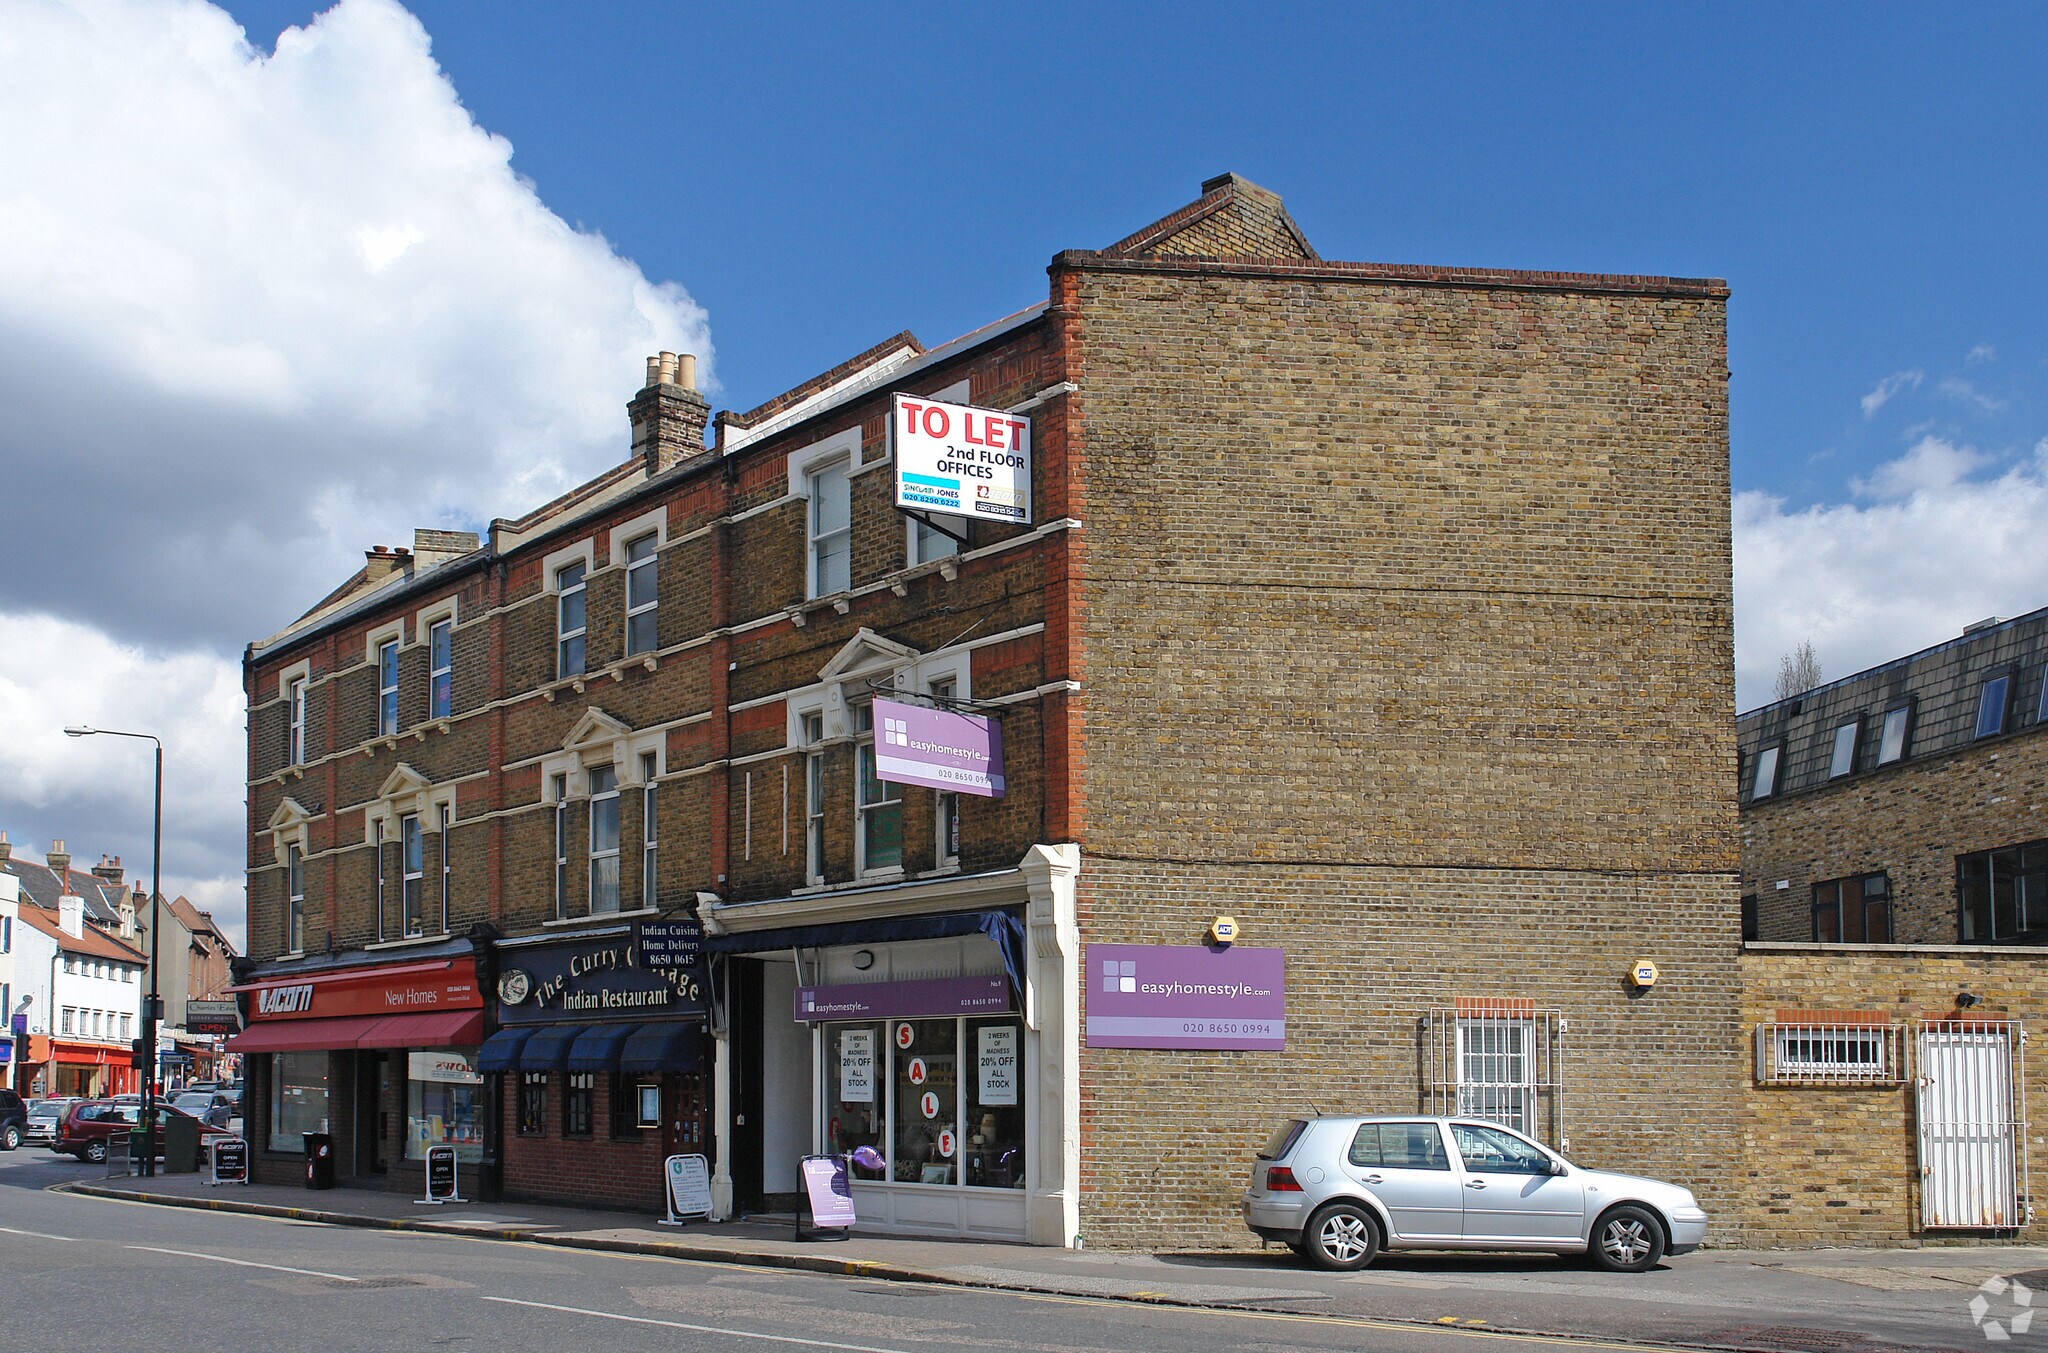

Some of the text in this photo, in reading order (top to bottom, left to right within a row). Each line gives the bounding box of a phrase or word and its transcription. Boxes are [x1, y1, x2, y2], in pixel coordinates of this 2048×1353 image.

[901, 402, 1026, 451] TO LET
[947, 445, 1025, 469] 2nd FLOOR
[937, 460, 993, 479] OFFICES
[936, 488, 959, 498] JONES
[910, 740, 992, 761] easyhomestyle.com
[938, 770, 953, 778] 020
[955, 773, 973, 782] 8650
[641, 925, 699, 936] Indian Cuisine
[1218, 924, 1233, 934] ADT
[643, 939, 699, 952] Home Delivery
[650, 954, 695, 964] 8650 0615
[534, 974, 564, 1008] The
[570, 949, 618, 977] Curry
[1639, 969, 1652, 978] ADT
[1141, 981, 1271, 998] easyhomestyle.com
[385, 989, 404, 1006] New
[406, 988, 437, 1004] Homes
[563, 986, 668, 1009] Indian Restaurant
[1183, 1023, 1270, 1034] 020 8650 0994
[843, 1058, 871, 1066] 20% OFF
[981, 1057, 1014, 1067] 20% OFF
